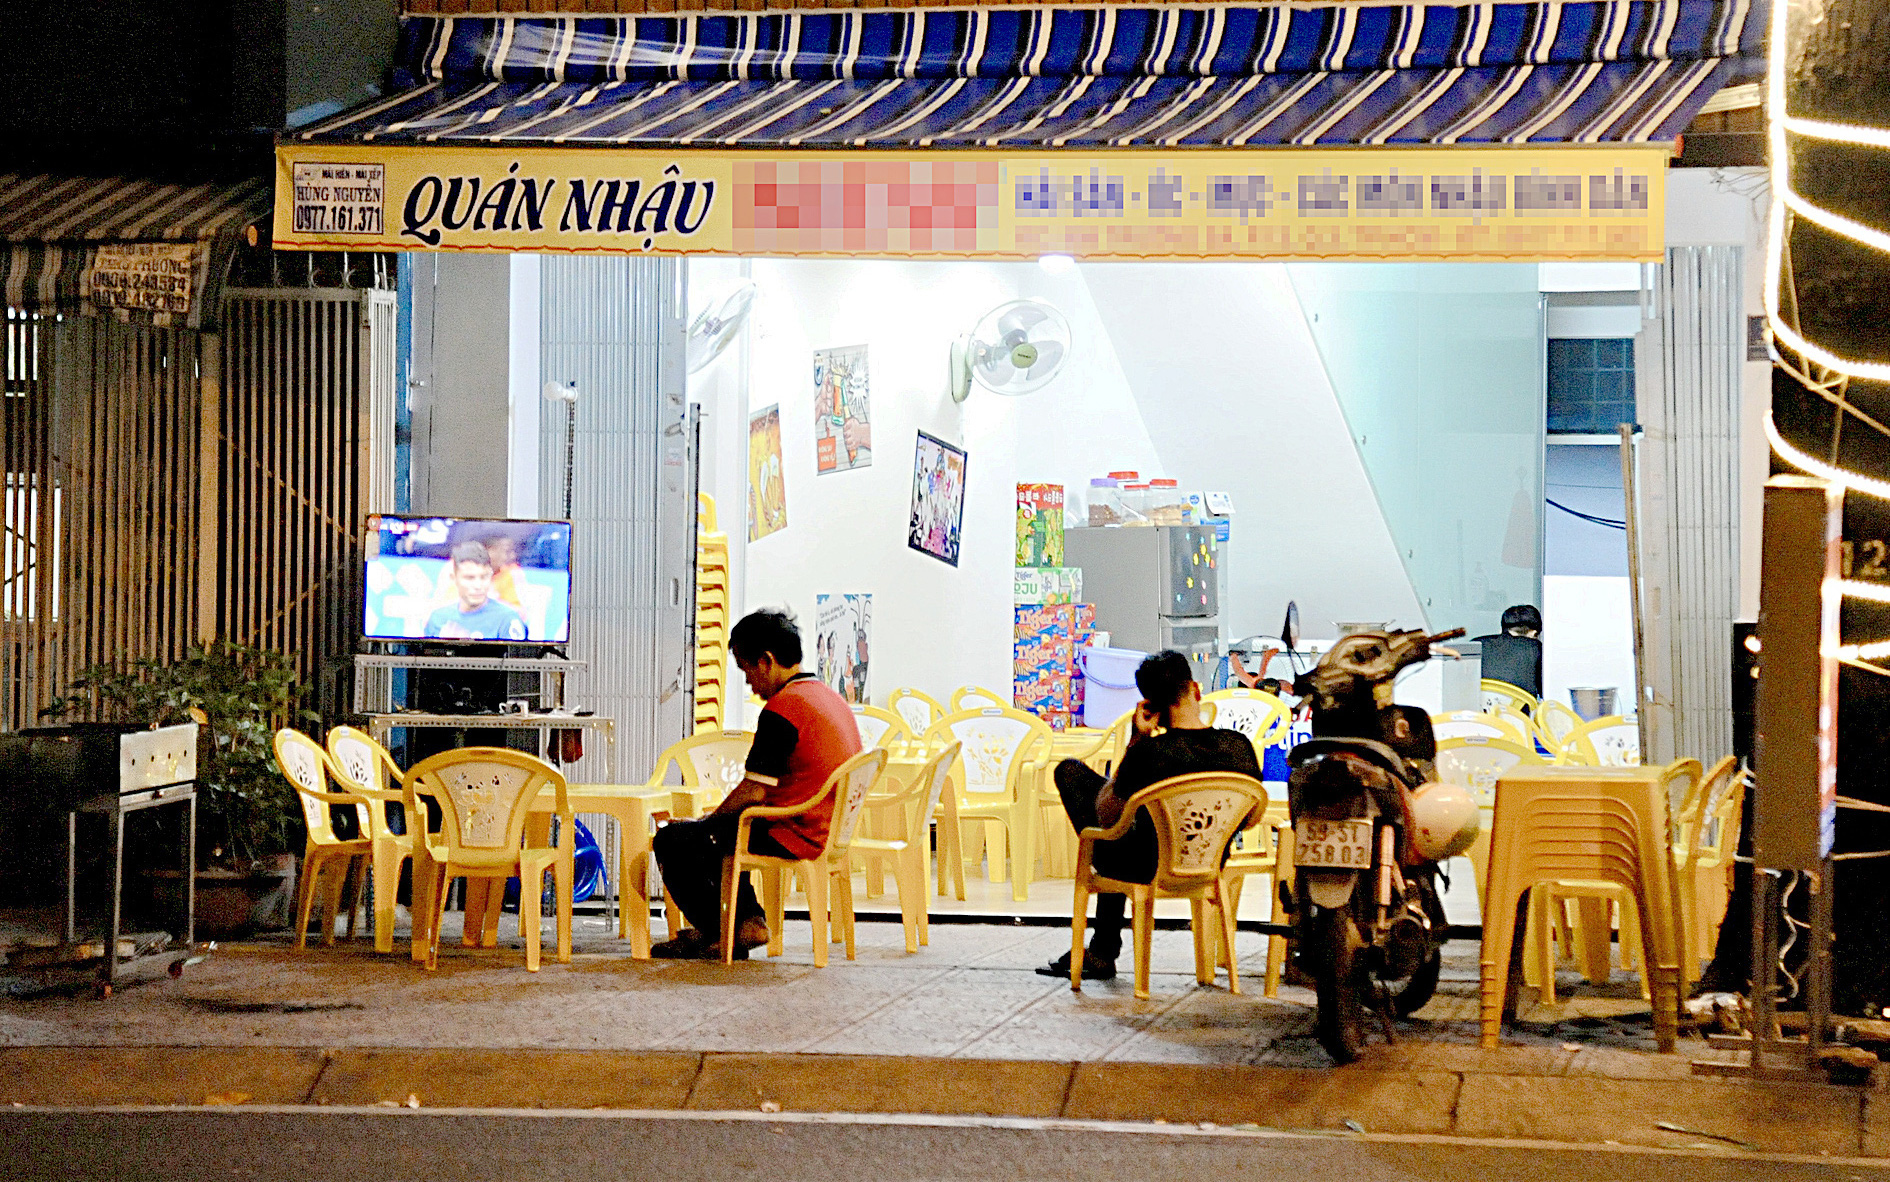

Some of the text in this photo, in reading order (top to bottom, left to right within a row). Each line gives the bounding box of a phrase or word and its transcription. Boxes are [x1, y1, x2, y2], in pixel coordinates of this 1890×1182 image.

[296, 182, 329, 201] HÙNG
[400, 162, 556, 246] QUÁN
[560, 164, 715, 249] NHẬU
[296, 204, 381, 231] 0977.161.371
[1841, 540, 1888, 579] 12
[1017, 608, 1056, 631] Tiger
[1015, 644, 1054, 666] Tiger
[1013, 679, 1051, 702] Tiger
